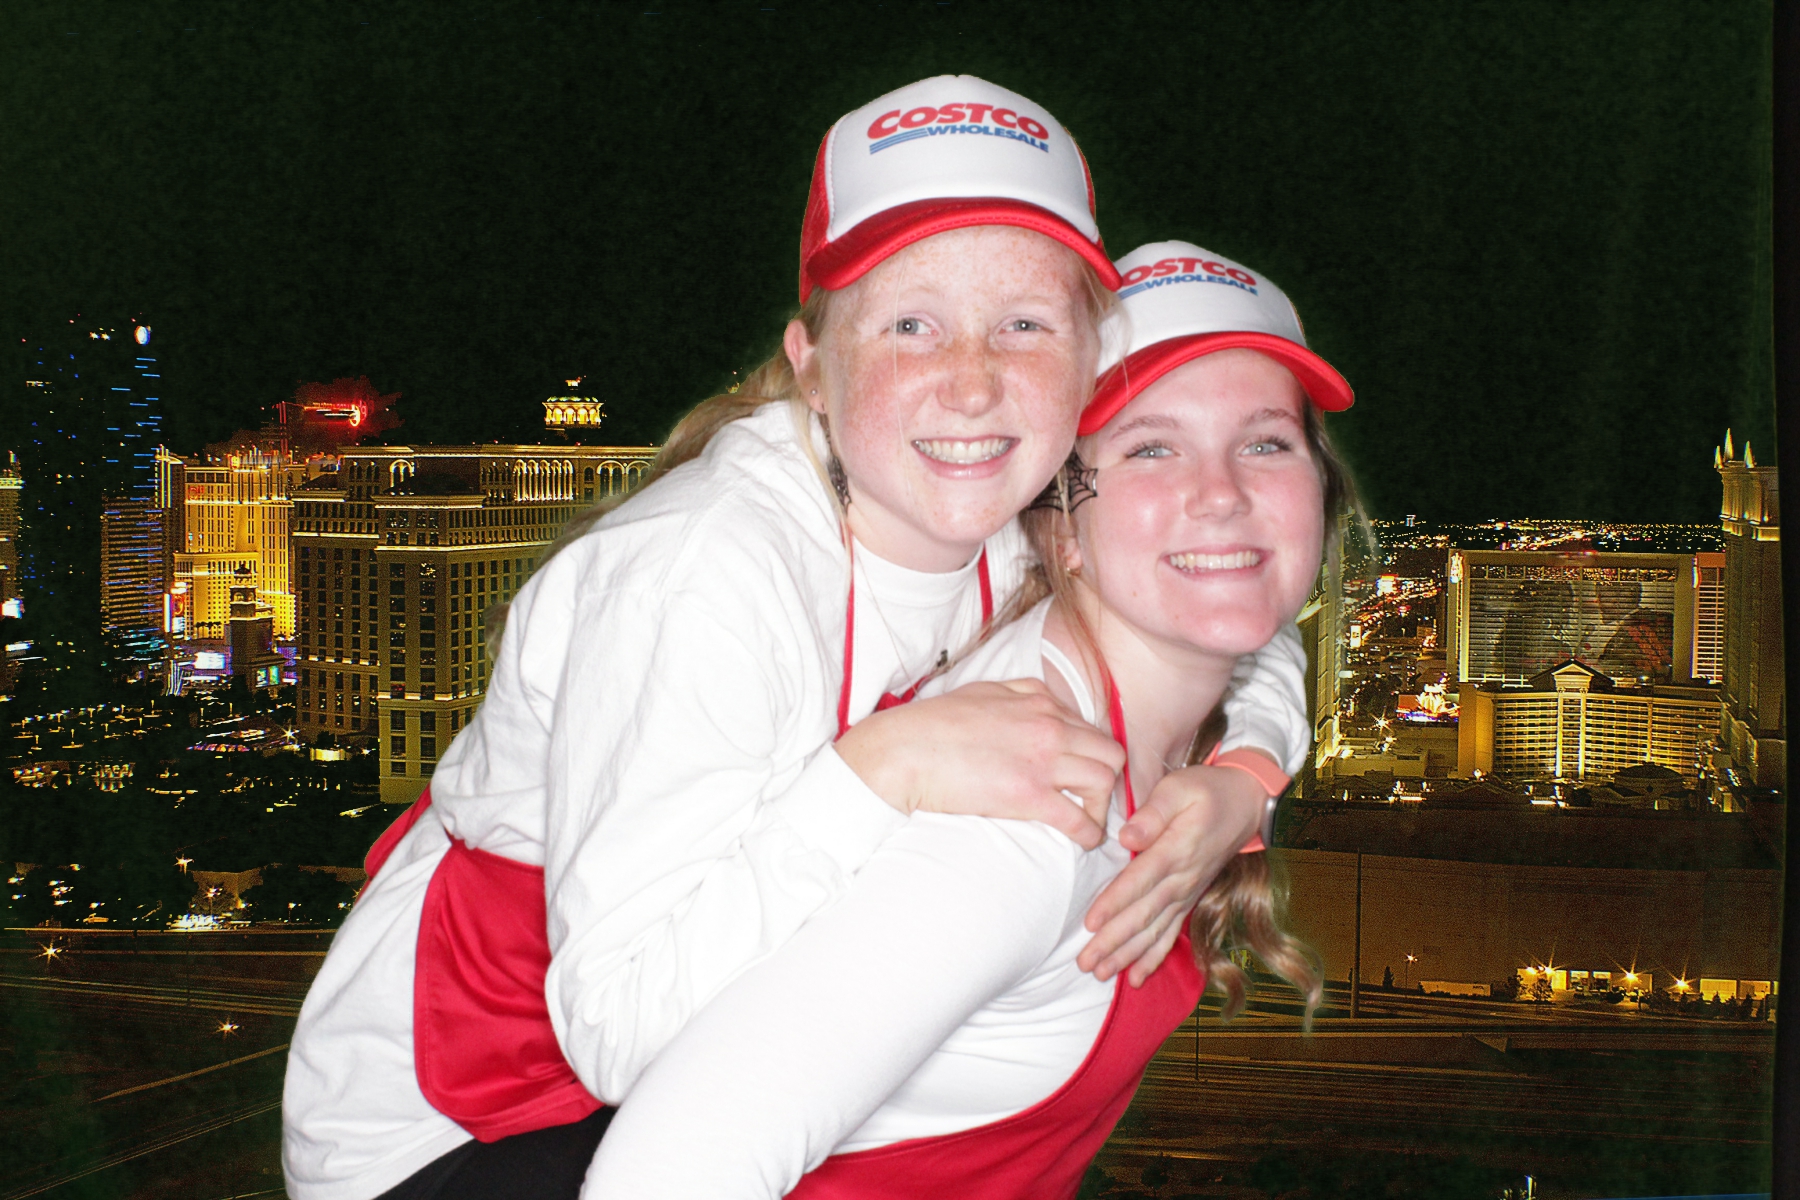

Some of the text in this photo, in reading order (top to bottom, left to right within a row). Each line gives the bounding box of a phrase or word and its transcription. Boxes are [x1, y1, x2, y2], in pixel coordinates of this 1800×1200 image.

[867, 103, 1049, 140] COSTCO
[927, 125, 1049, 153] WHOLESALE
[1121, 257, 1257, 287] OSTCO
[1145, 274, 1259, 296] WHOLESALE
